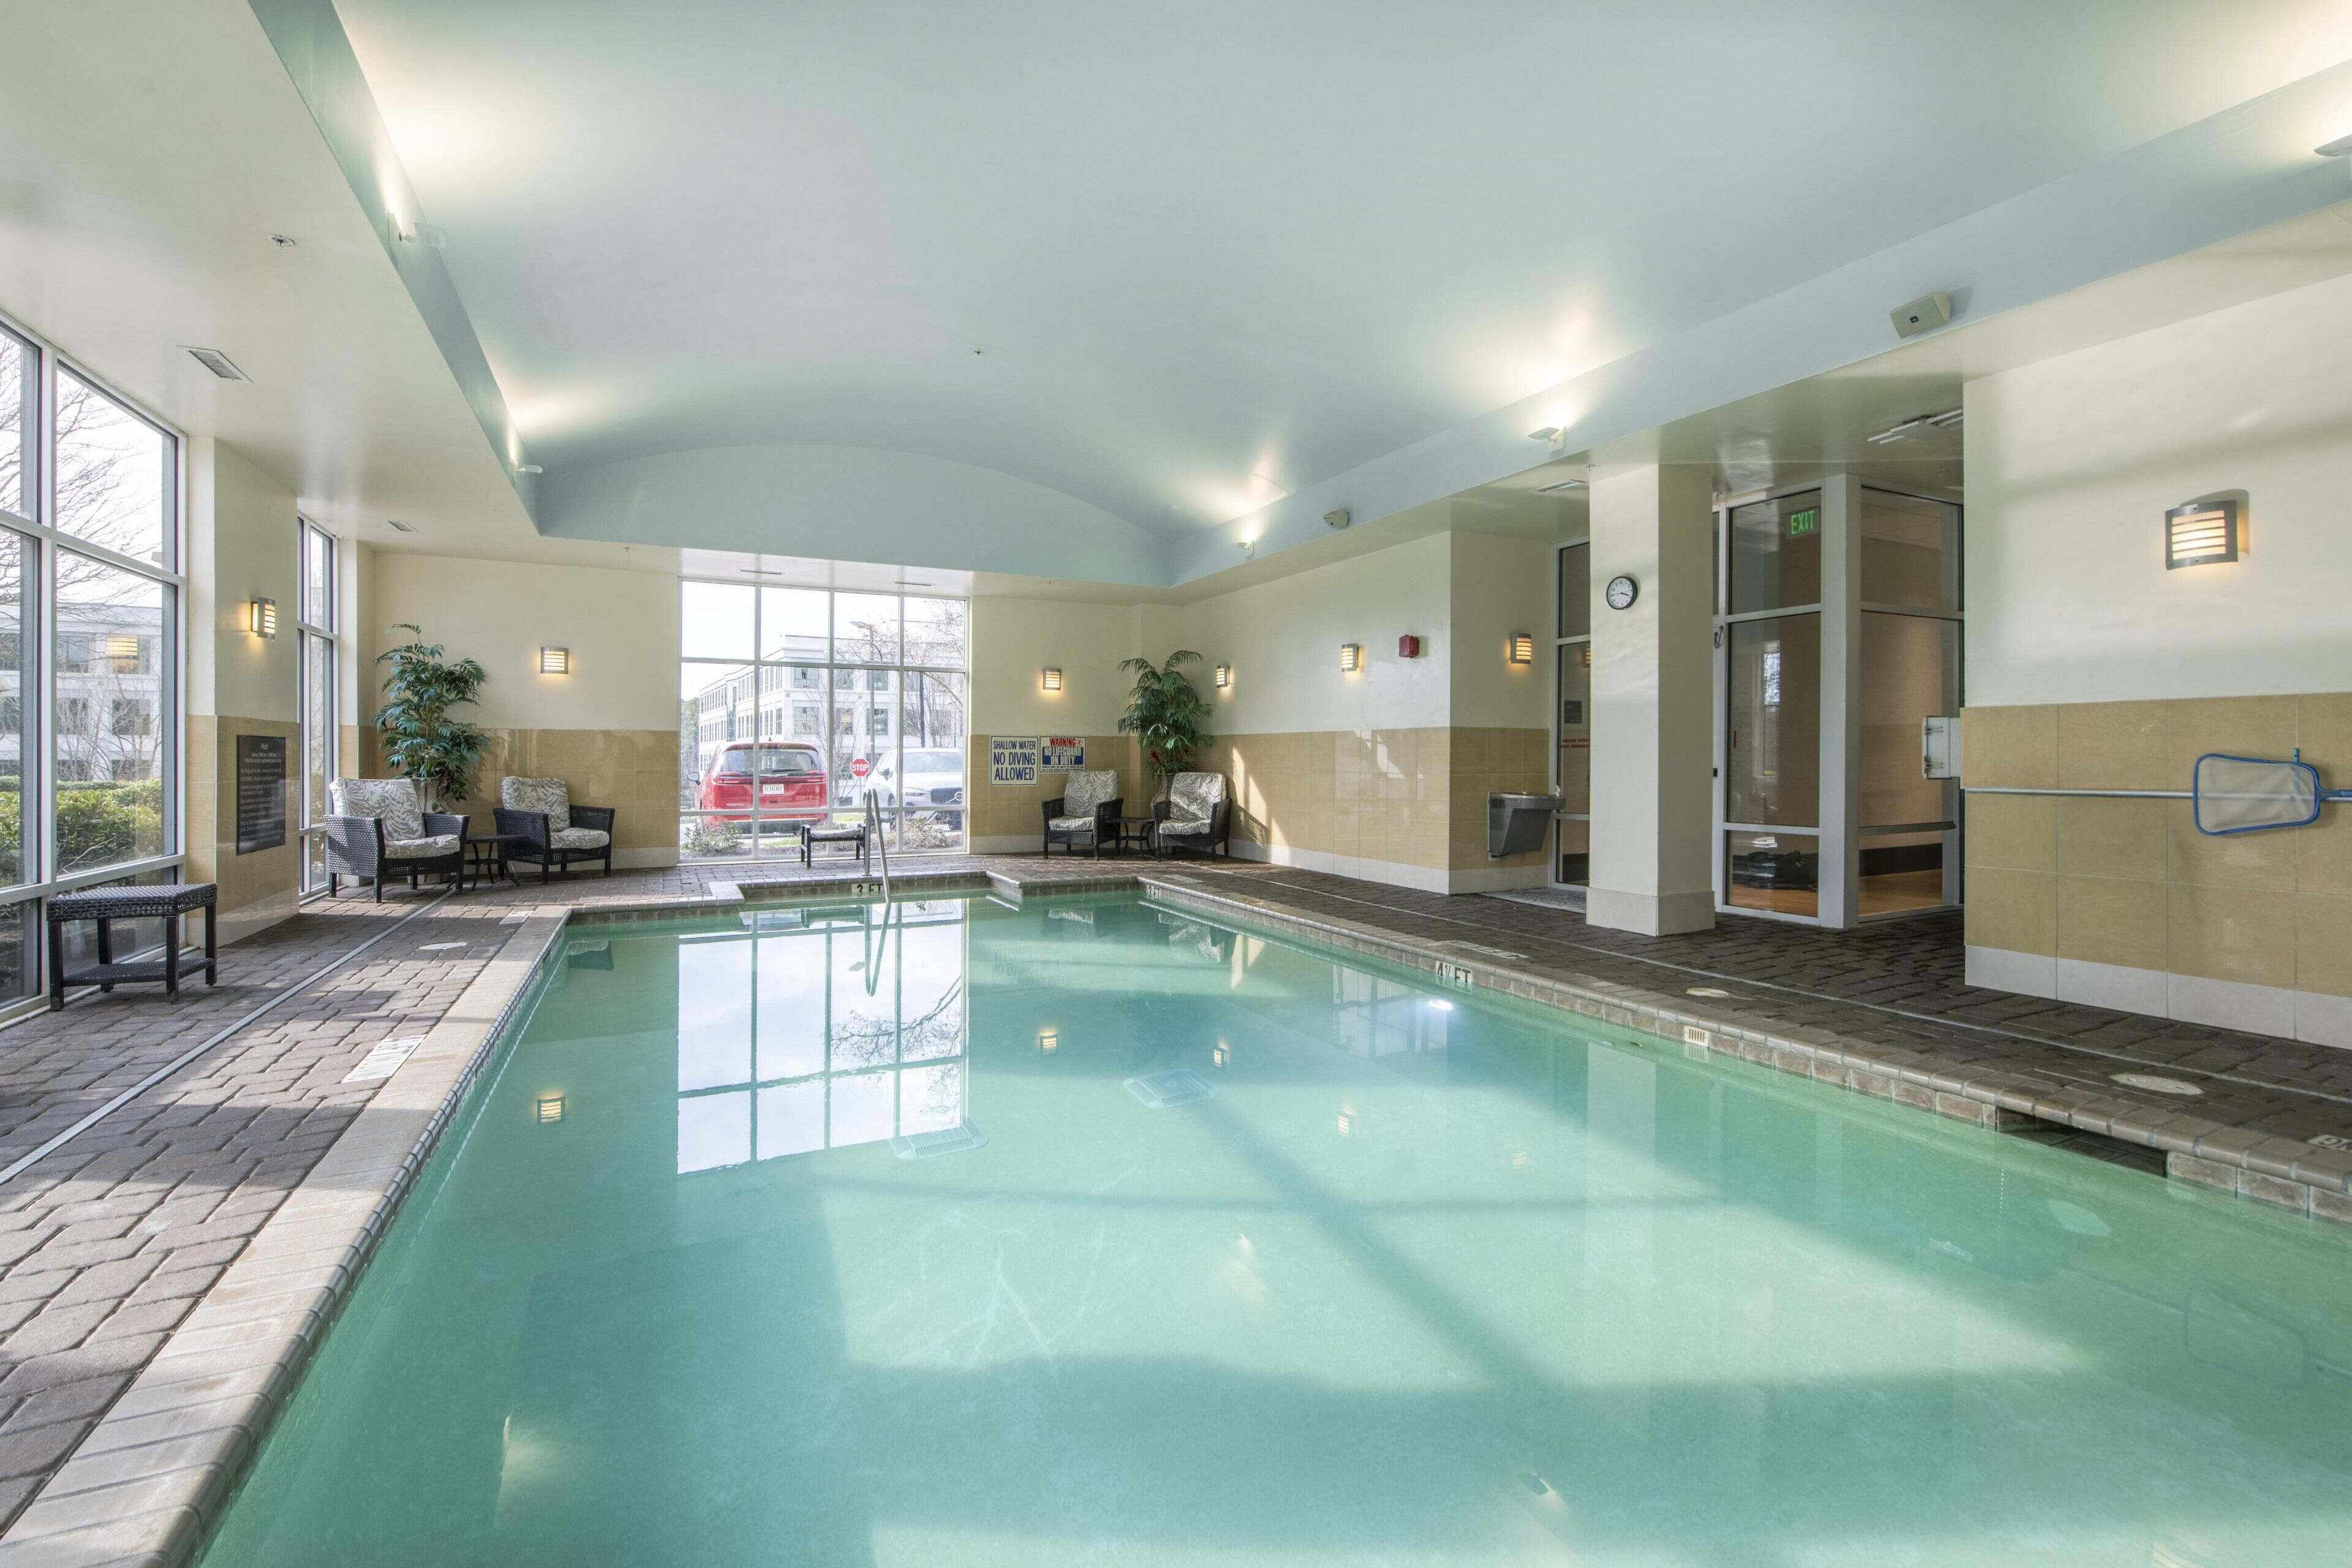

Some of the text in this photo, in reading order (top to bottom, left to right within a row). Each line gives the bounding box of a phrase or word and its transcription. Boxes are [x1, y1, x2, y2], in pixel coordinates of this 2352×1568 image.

[1790, 510, 1815, 535] EXIT
[993, 740, 1036, 750] SHALLOW WATER
[1050, 737, 1076, 747] WARNING
[1044, 747, 1082, 756] NO LIFEGUARD
[993, 752, 1036, 766] NO DIVING
[1050, 756, 1076, 765] ON DUTY
[994, 767, 1035, 780] ALLOWED
[869, 883, 883, 892] FT
[1455, 967, 1471, 983] FT
